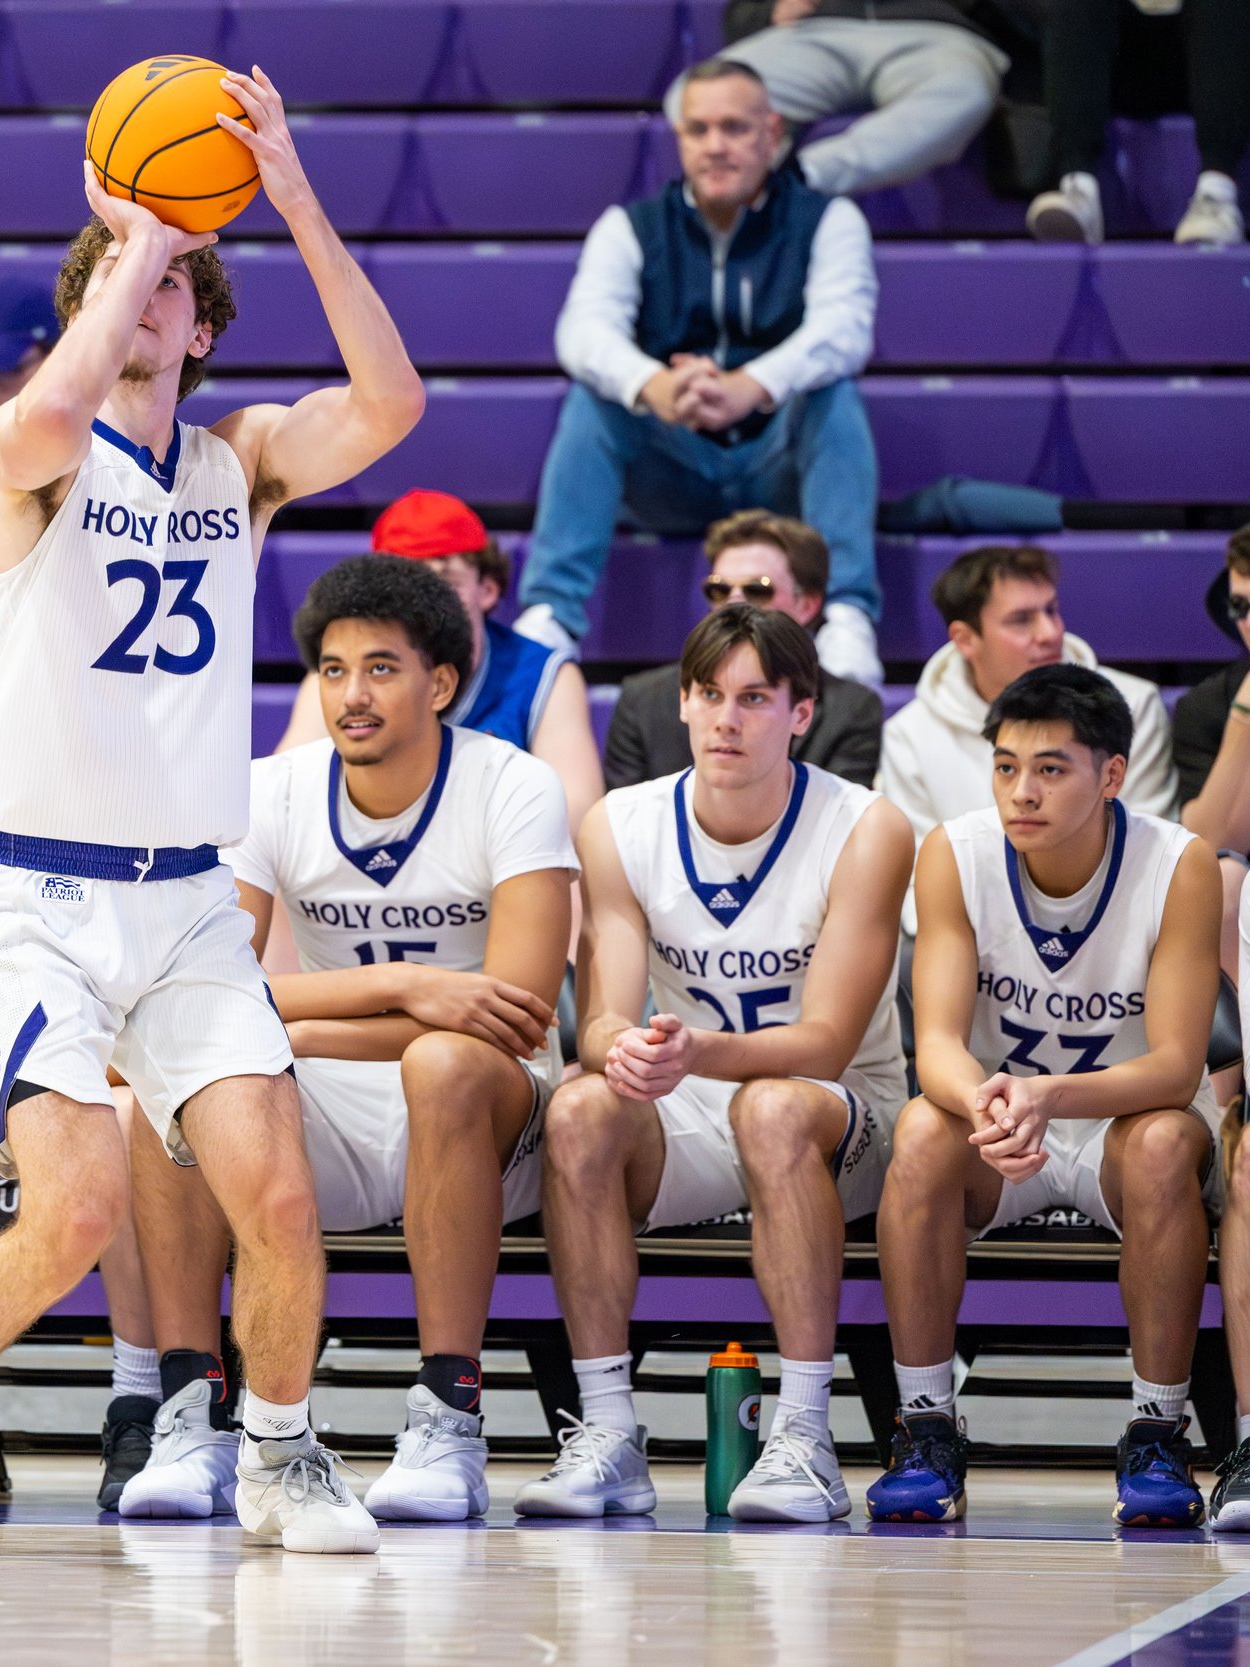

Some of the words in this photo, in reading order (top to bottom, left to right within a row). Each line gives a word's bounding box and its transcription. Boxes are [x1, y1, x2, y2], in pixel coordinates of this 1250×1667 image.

[81, 498, 159, 546] HOLY
[167, 507, 240, 543] ROSS
[90, 558, 216, 676] 23
[42, 887, 86, 896] PATRIOT
[42, 893, 86, 902] LEAGUE
[709, 900, 740, 909] adidas
[300, 899, 371, 929] HOLY
[381, 901, 488, 929] CROSS
[651, 936, 709, 978] HOLY
[1038, 945, 1069, 958] adidas
[977, 971, 1038, 1015] HOLY
[1045, 991, 1146, 1023] CROSS
